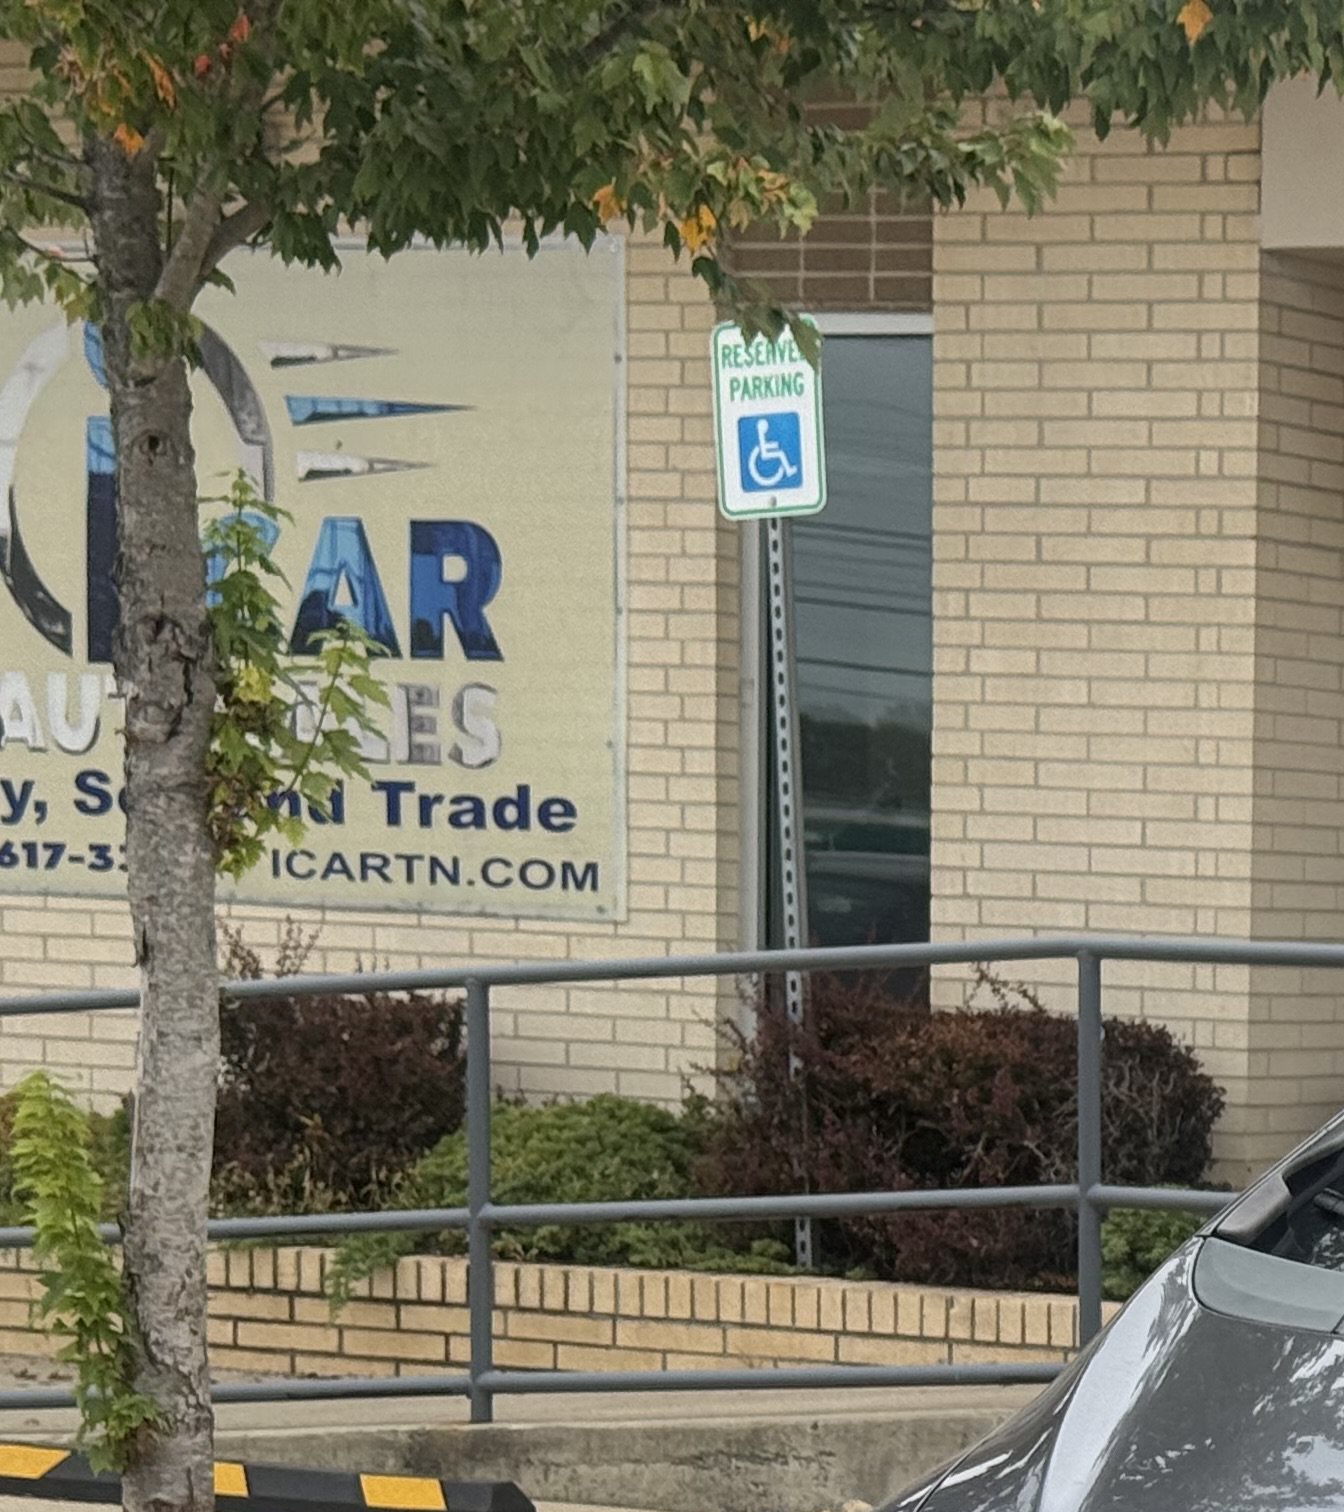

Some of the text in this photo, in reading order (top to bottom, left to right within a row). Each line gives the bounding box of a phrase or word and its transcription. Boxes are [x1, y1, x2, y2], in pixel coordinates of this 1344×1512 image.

[721, 340, 806, 368] RESERVE
[730, 373, 804, 401] PARKING
[371, 780, 578, 832] Trade
[272, 848, 600, 892] ICARTN.COM
